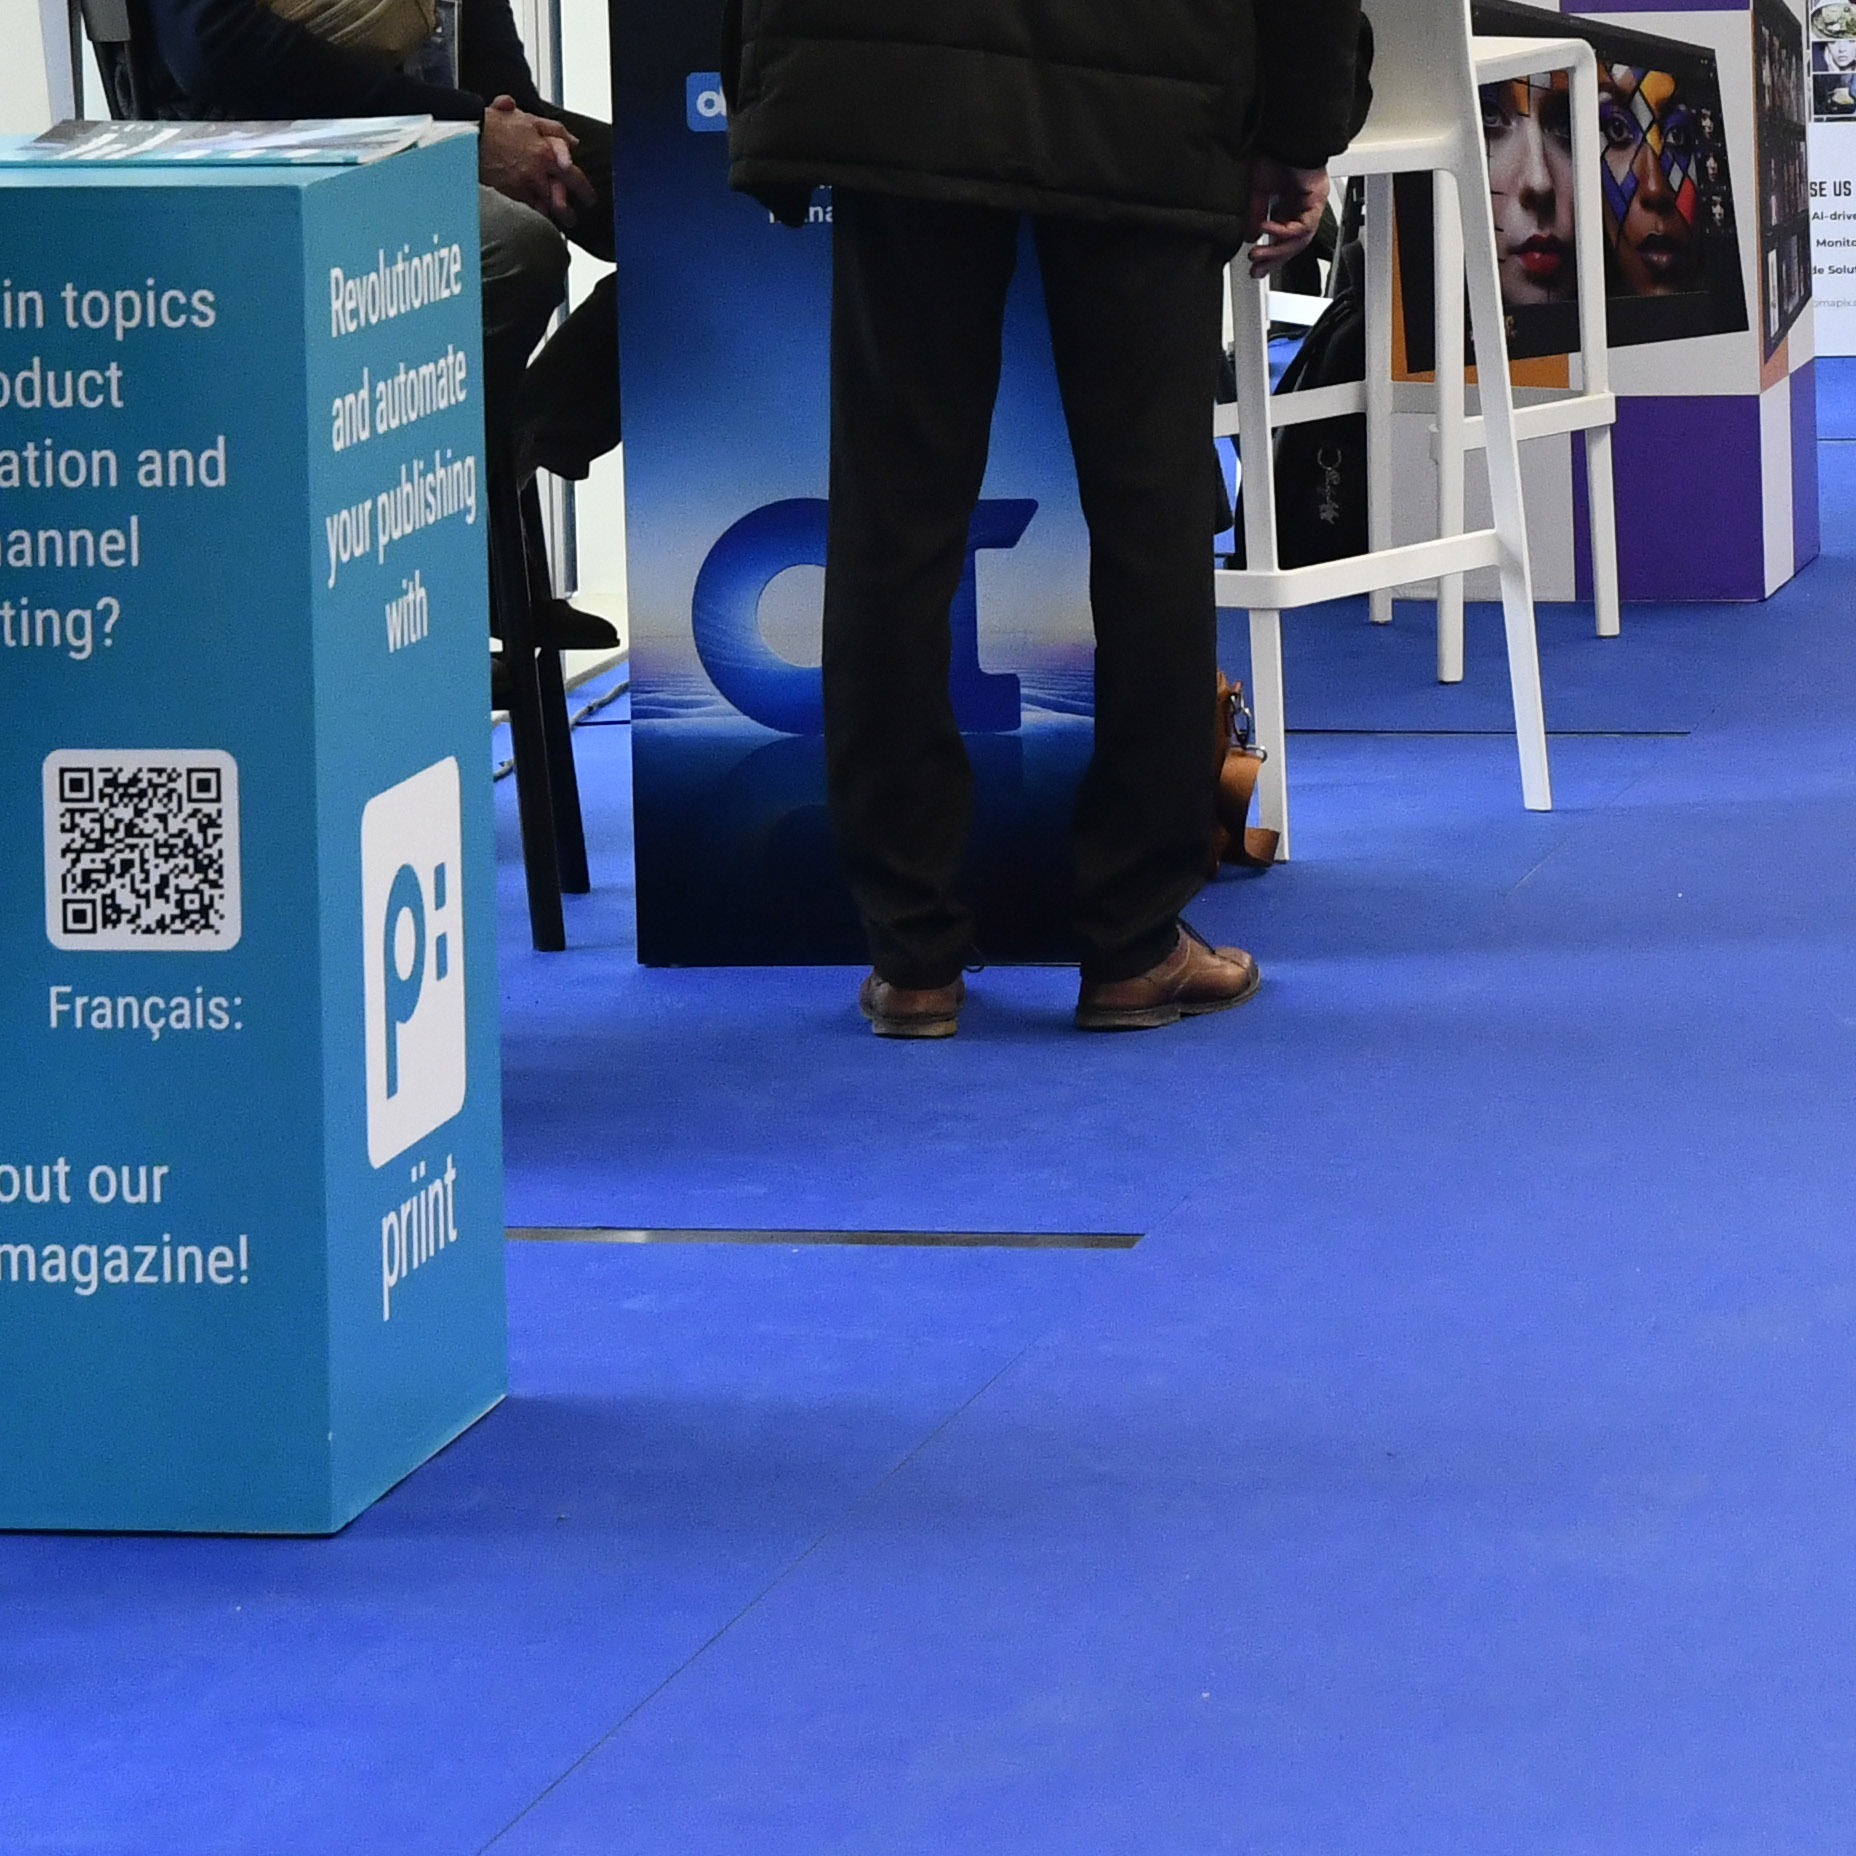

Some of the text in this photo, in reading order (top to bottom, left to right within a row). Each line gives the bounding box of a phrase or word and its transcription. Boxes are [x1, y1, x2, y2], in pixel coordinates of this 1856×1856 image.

[1833, 180, 1852, 197] US
[2, 278, 45, 329] in
[60, 277, 217, 342] topics
[330, 233, 463, 338] Revolutionize
[331, 343, 468, 453] and automate
[136, 435, 227, 488] and
[325, 448, 477, 590] your publishing
[384, 569, 430, 654] with
[48, 984, 244, 1042] Français:
[87, 1162, 170, 1205] our
[381, 1154, 459, 1322] priint
